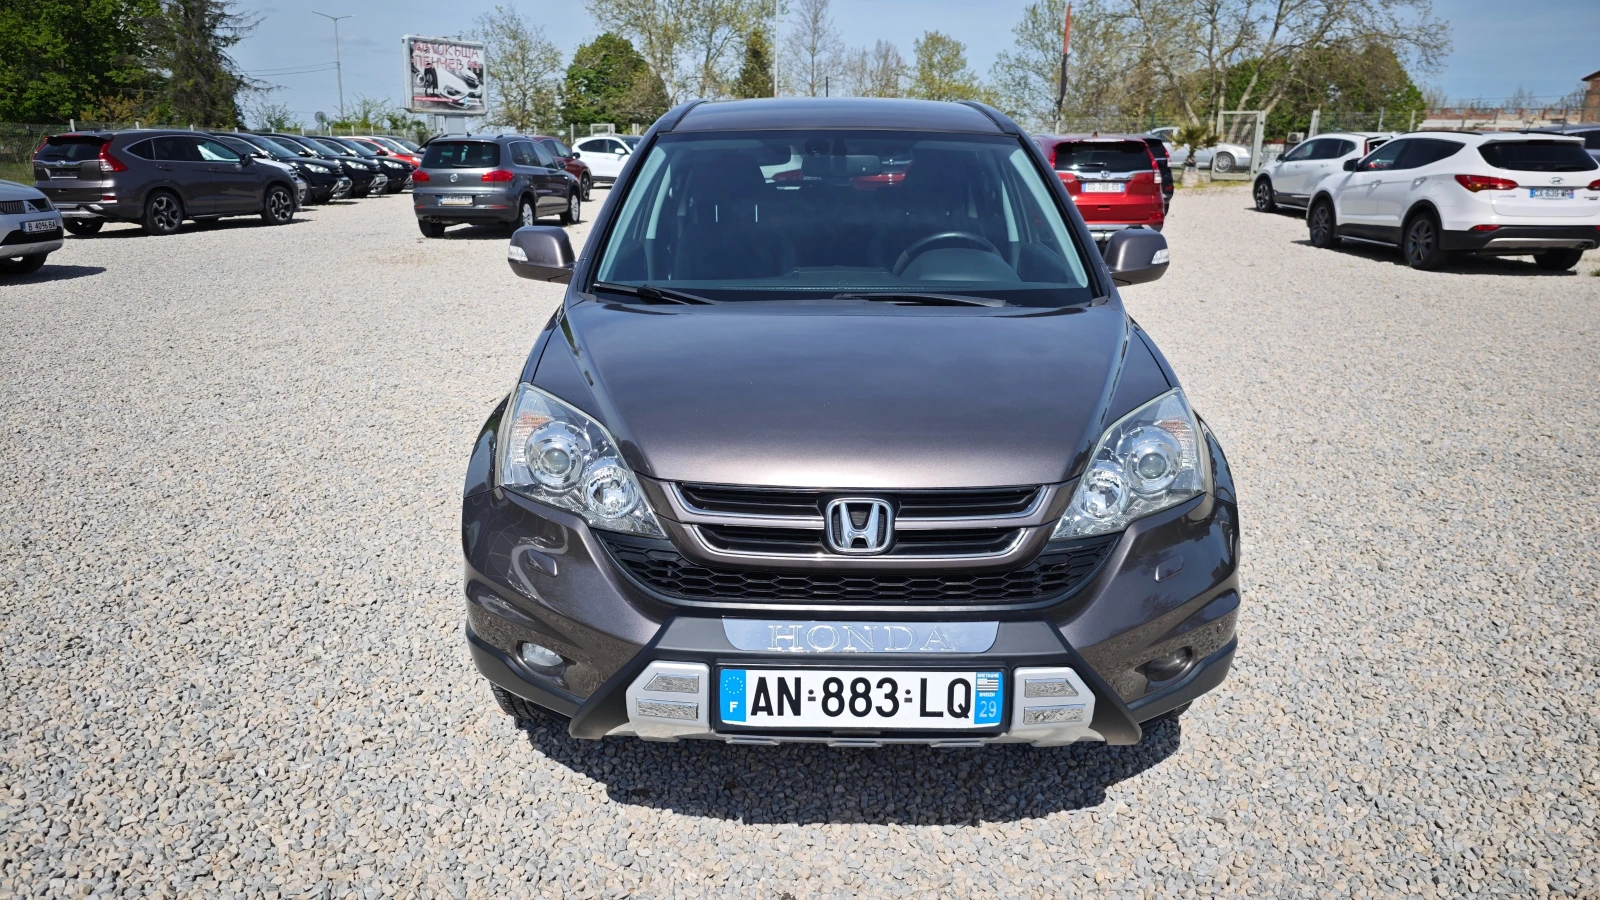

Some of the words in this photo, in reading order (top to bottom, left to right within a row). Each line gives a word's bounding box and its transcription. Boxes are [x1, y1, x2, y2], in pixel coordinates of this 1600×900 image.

[767, 624, 957, 651] HONDA
[729, 701, 738, 713] F
[978, 700, 997, 718] 29
